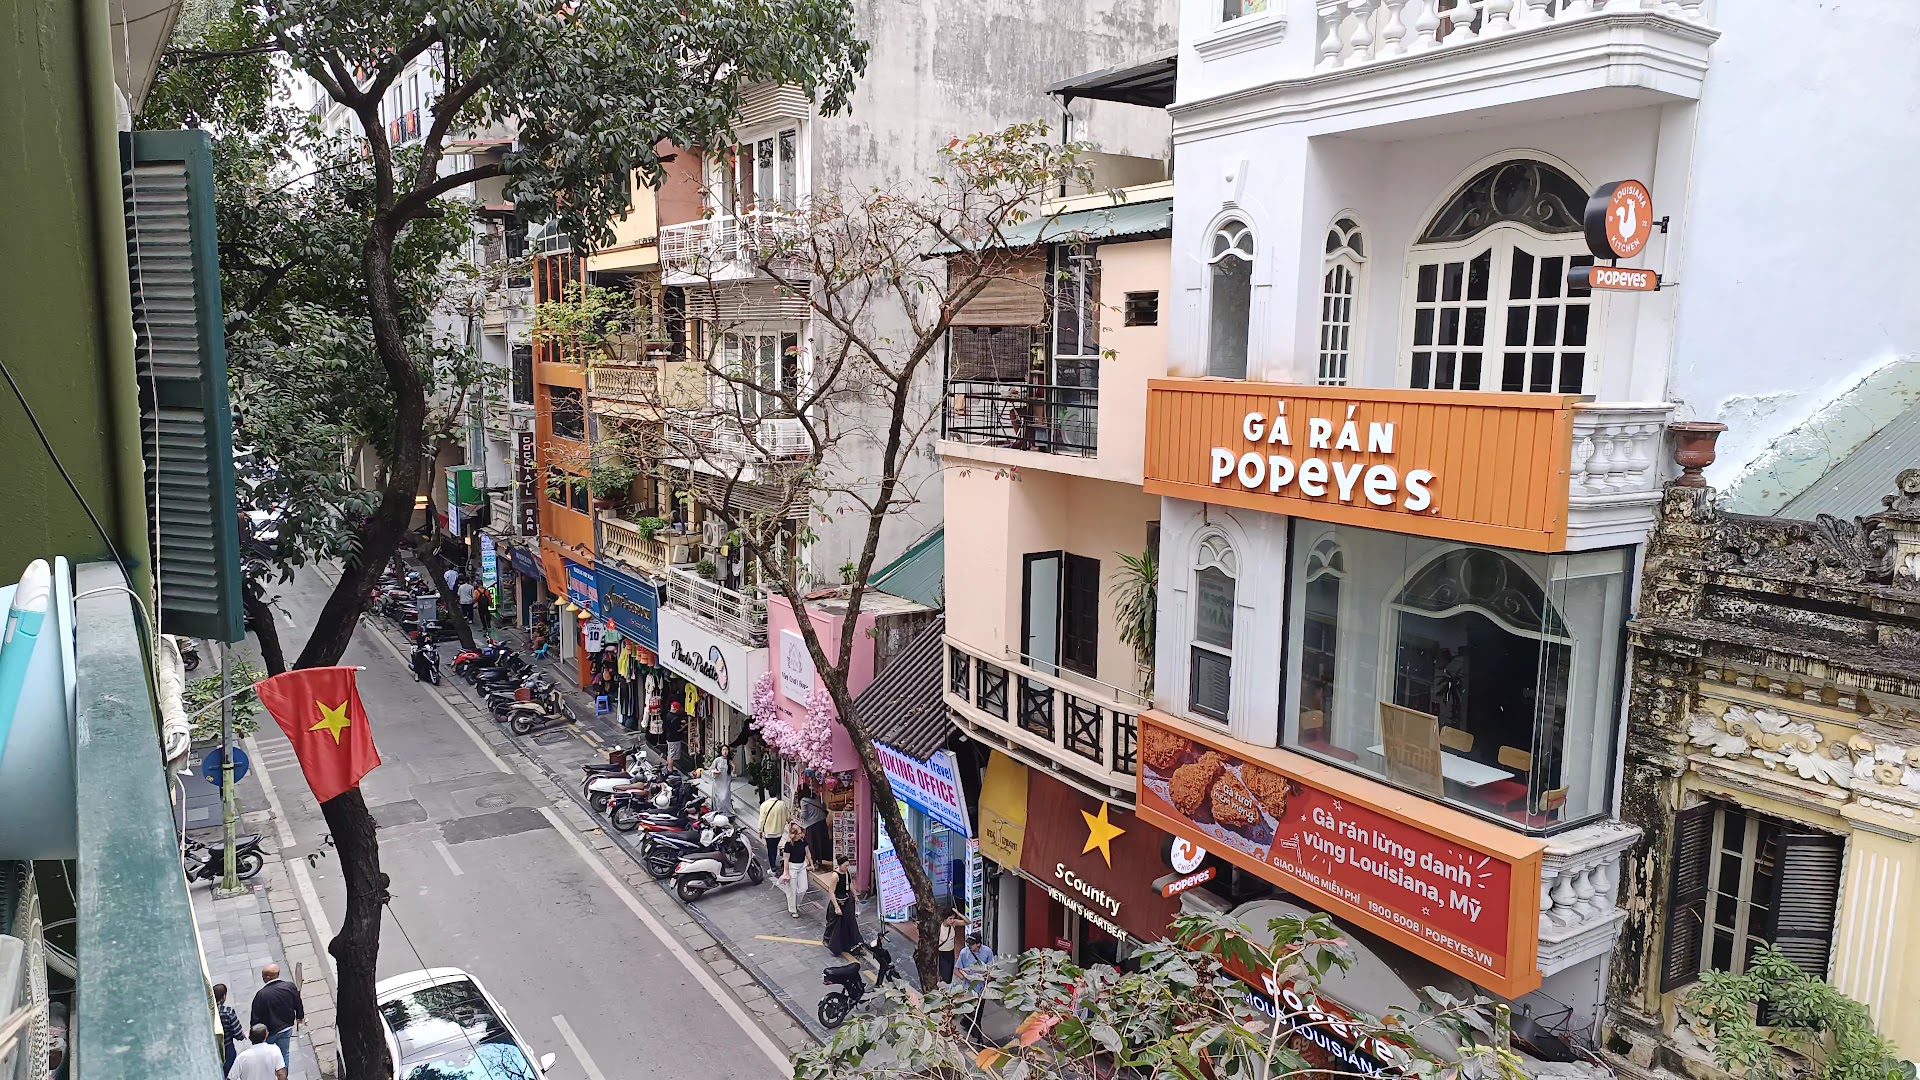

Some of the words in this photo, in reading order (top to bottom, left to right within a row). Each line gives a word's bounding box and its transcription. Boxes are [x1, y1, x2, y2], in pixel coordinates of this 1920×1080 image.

[1613, 186, 1647, 209] LOUISIANA
[1611, 235, 1640, 253] KITCHEN
[1243, 400, 1293, 446] GÀ
[1309, 404, 1396, 454] RÁN
[522, 436, 533, 496] COCKTAIL
[525, 508, 534, 531] BAR
[589, 631, 600, 641] 10
[875, 747, 916, 785] OOKING
[916, 768, 957, 807] OFFICE
[929, 758, 953, 781] Travel
[1312, 807, 1335, 832] Gà
[1338, 821, 1369, 845] rán
[1372, 830, 1416, 868] lừng
[1420, 852, 1472, 888] danh
[1303, 830, 1346, 864] vùng
[1349, 847, 1445, 908] Louisiana,
[1450, 889, 1482, 922] Mỹ
[1048, 886, 1084, 916] VIETNAM'S
[1083, 907, 1128, 942] HEARTBEAT
[1273, 856, 1295, 873] GIAO
[1295, 866, 1320, 887] HÀNG
[1321, 877, 1344, 897] MIỄN
[1344, 889, 1361, 905] PHÍ
[1368, 900, 1392, 919] 1900
[1393, 913, 1420, 933] 6008
[1425, 927, 1493, 967] POPEYES.VN
